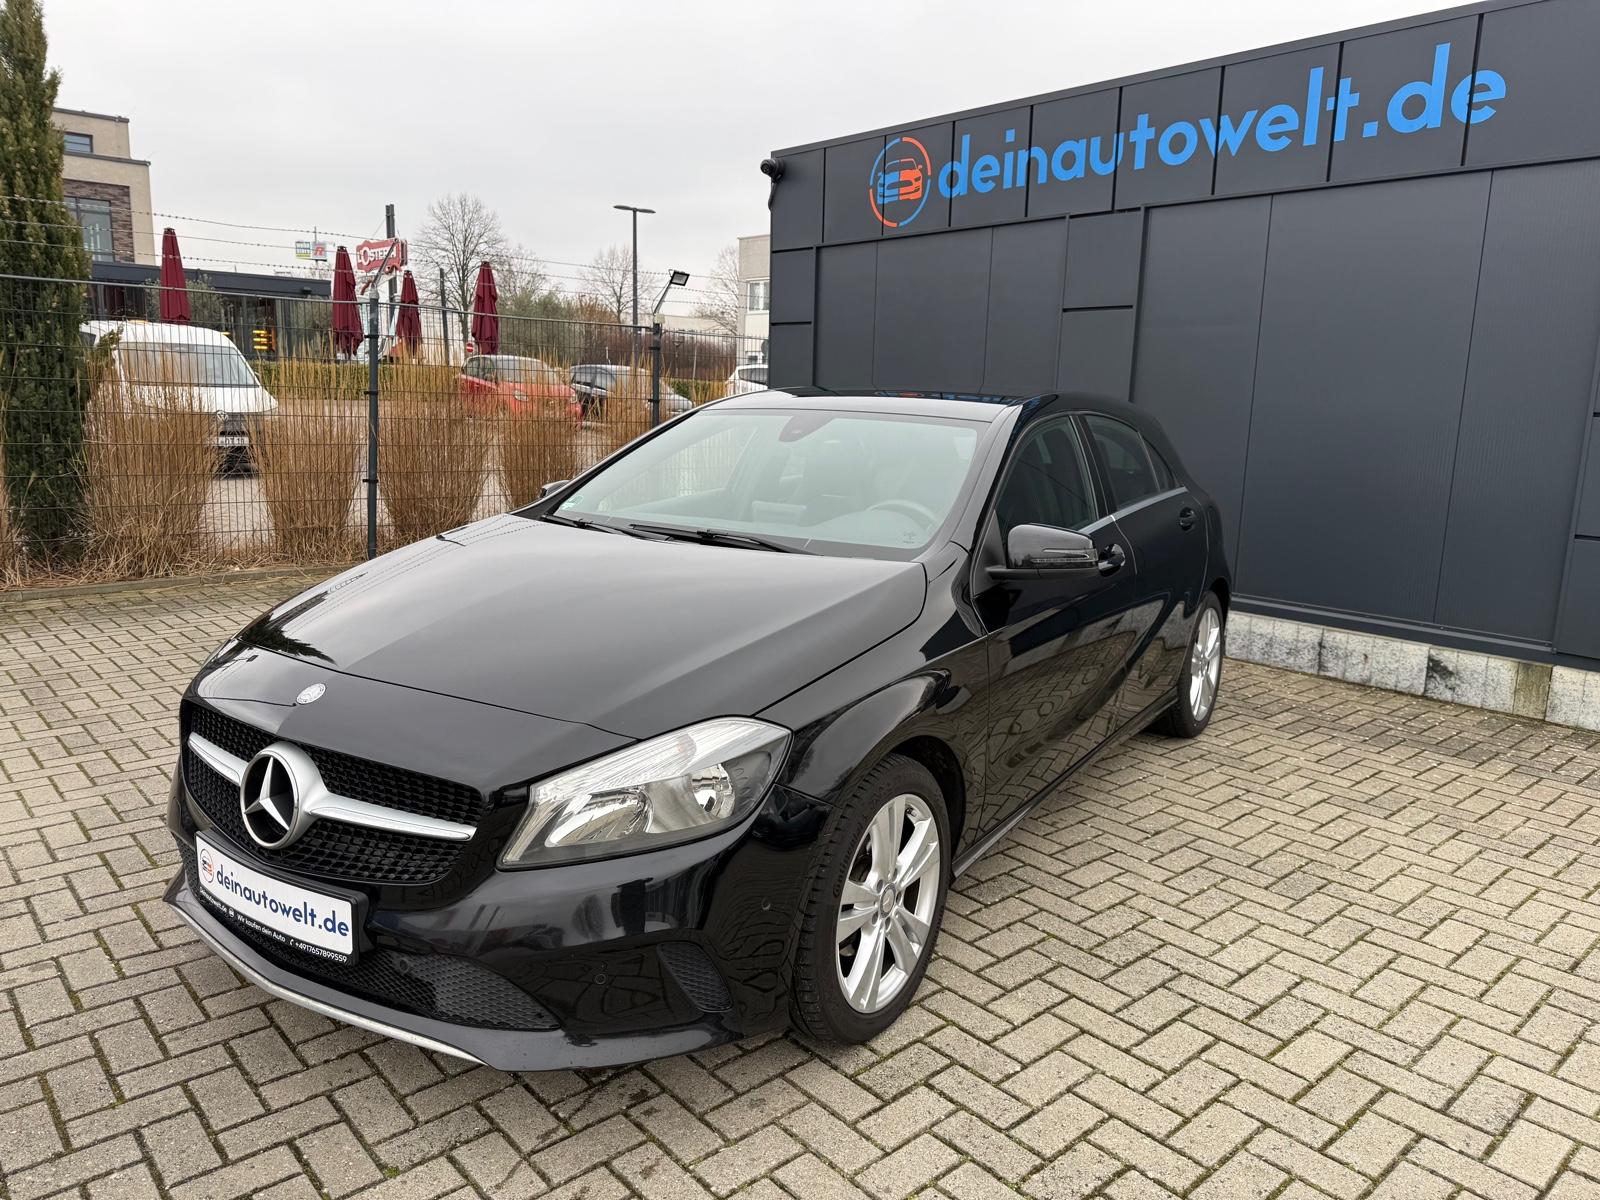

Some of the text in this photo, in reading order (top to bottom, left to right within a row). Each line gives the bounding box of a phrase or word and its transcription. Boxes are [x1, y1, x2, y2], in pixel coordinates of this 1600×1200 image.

[938, 43, 1506, 197] deinautowelt.de
[216, 864, 350, 937] deinautowelt.de
[272, 931, 286, 943] Auto
